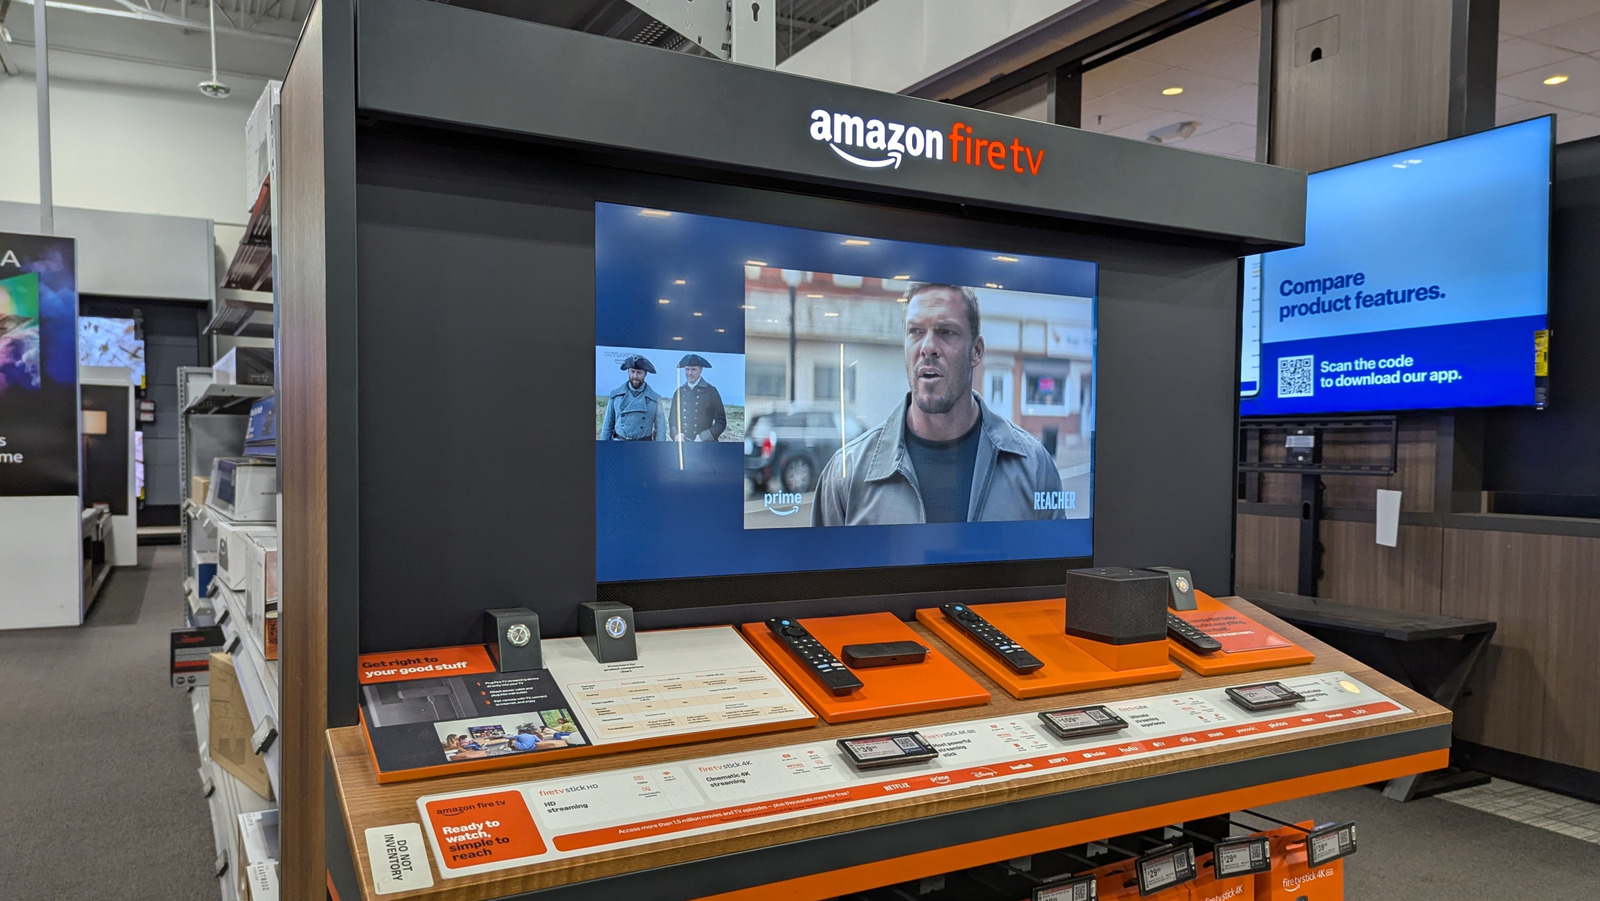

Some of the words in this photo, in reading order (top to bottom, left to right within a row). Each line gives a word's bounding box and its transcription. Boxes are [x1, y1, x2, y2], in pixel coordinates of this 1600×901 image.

[810, 109, 943, 165] amazon
[1279, 271, 1365, 298] Compare
[1279, 294, 1351, 322] product
[1354, 284, 1446, 310] features.
[1320, 359, 1352, 374] Scan
[1353, 358, 1376, 372] the
[1378, 354, 1414, 369] code
[1320, 376, 1333, 389] to
[1335, 372, 1400, 388] download
[1402, 371, 1428, 384] our
[1429, 370, 1462, 385] app.
[764, 490, 802, 509] prime
[1033, 491, 1076, 510] REACHER
[362, 661, 387, 669] Get
[389, 657, 422, 667] right
[365, 668, 397, 679] your
[399, 664, 434, 675] good
[434, 661, 468, 671] stuff
[883, 782, 911, 791] NETFLIX
[930, 775, 950, 784] prime
[1118, 745, 1139, 753] hulu
[706, 773, 740, 782] Cinematic
[710, 778, 746, 788] streaming
[565, 784, 587, 794] stick
[437, 804, 475, 816] amazon
[547, 802, 589, 813] streaming
[742, 806, 768, 814] episodes
[784, 797, 813, 806] thousands
[442, 822, 483, 835] Ready
[485, 820, 500, 828] to
[446, 830, 491, 843] watch,
[397, 839, 406, 852] DO
[449, 839, 494, 852] simple
[384, 834, 403, 882] INVENTORY
[400, 852, 413, 871] NOT
[452, 849, 492, 861] reach
[1316, 869, 1326, 878] 4K
[1234, 885, 1243, 894] 4K
